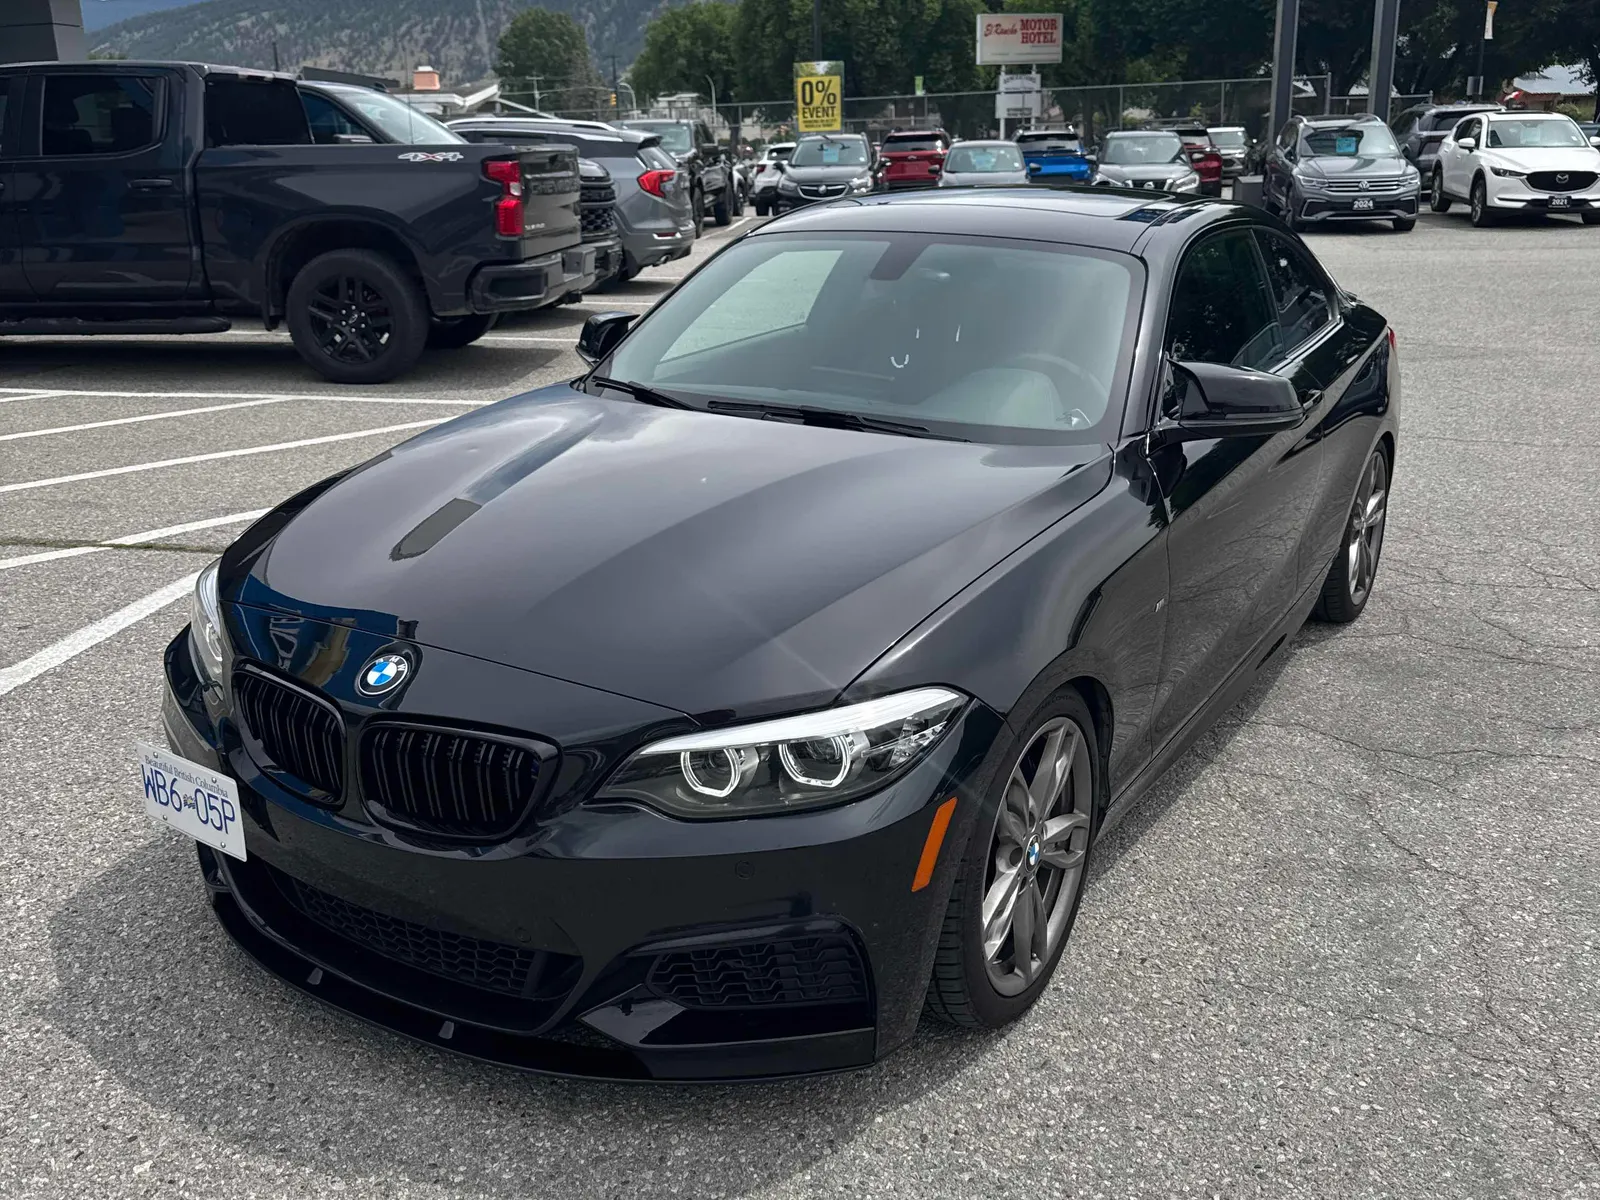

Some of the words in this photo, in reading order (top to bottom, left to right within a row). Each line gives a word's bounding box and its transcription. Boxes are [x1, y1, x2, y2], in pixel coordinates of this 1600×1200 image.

[1020, 18, 1058, 31] MOTOR
[1020, 31, 1057, 44] HOTEL
[801, 79, 837, 106] 0%
[802, 105, 836, 119] EVENT
[1353, 199, 1374, 209] 2024
[1551, 198, 1568, 206] 2021
[145, 755, 174, 776] Beautiful
[174, 768, 195, 783] British
[194, 778, 229, 799] Columbia
[141, 764, 183, 813] WB6
